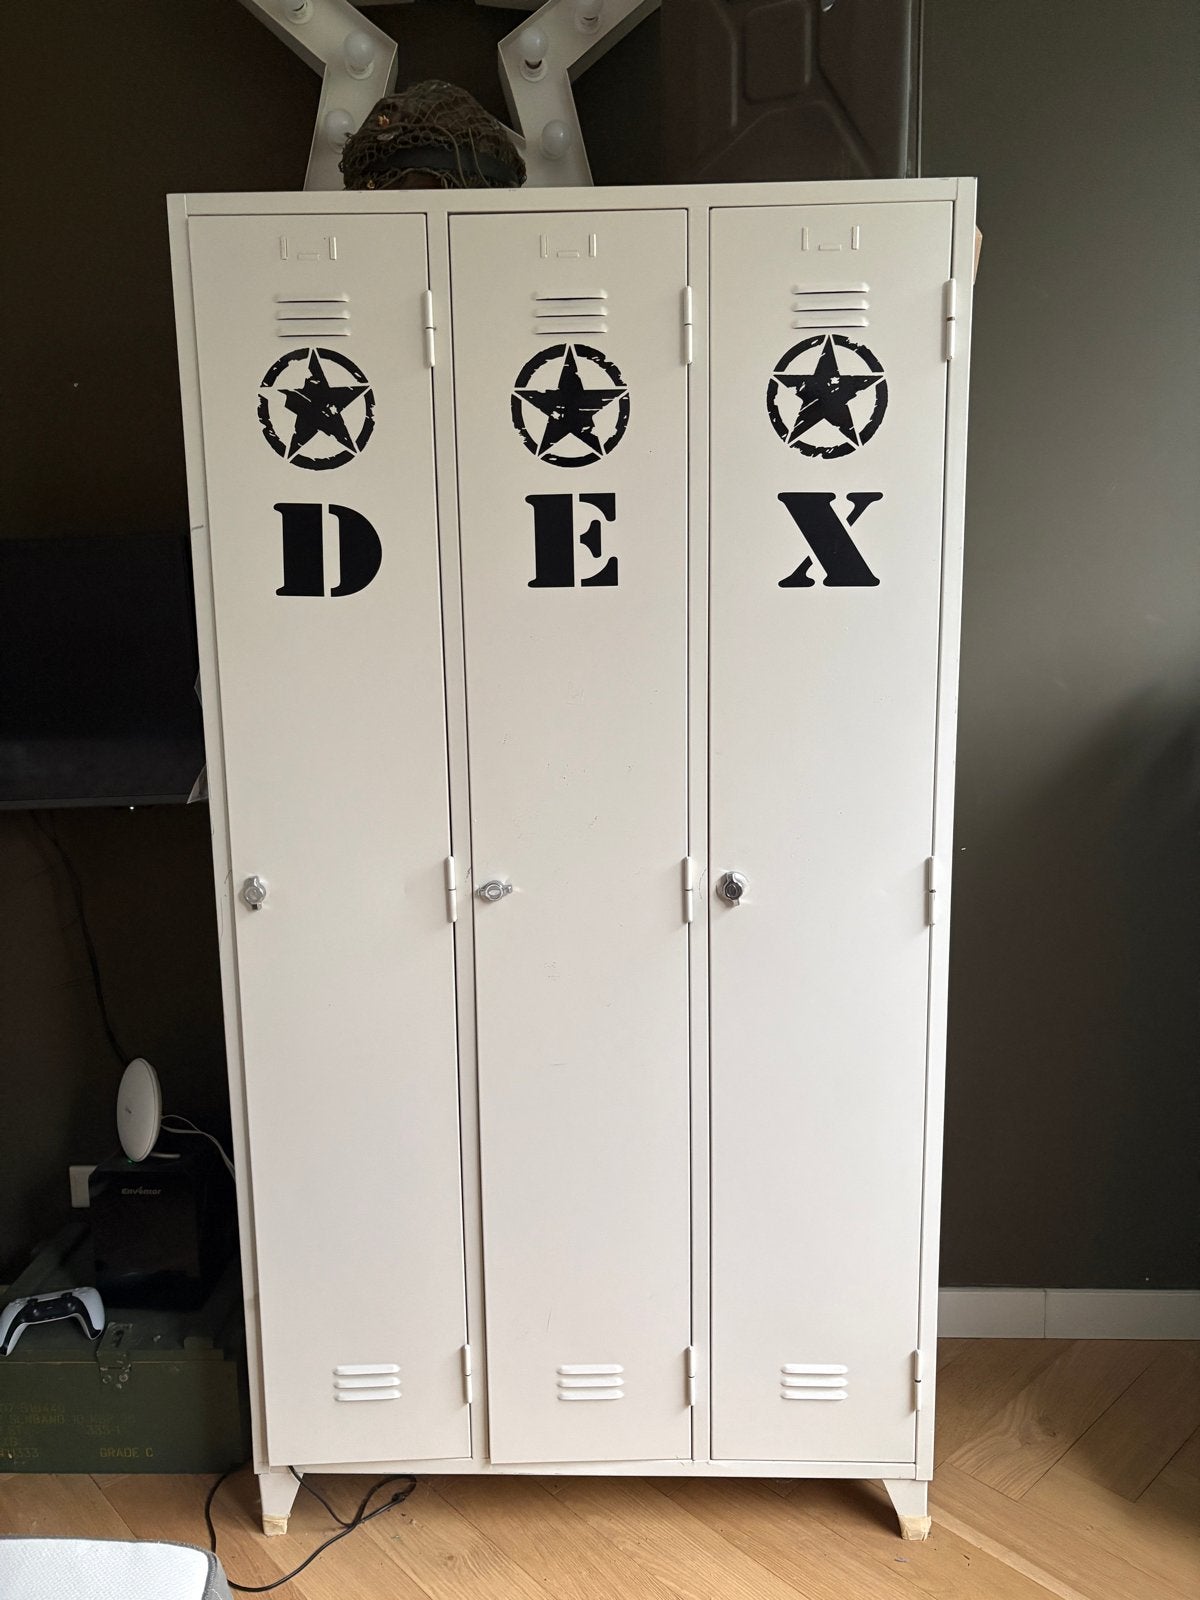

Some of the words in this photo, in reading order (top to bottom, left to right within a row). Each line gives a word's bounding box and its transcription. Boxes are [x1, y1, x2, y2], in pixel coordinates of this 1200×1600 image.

[274, 503, 382, 597] D
[525, 493, 618, 588] E
[778, 492, 883, 588] X
[99, 1447, 140, 1458] GRADE
[145, 1447, 154, 1458] C
